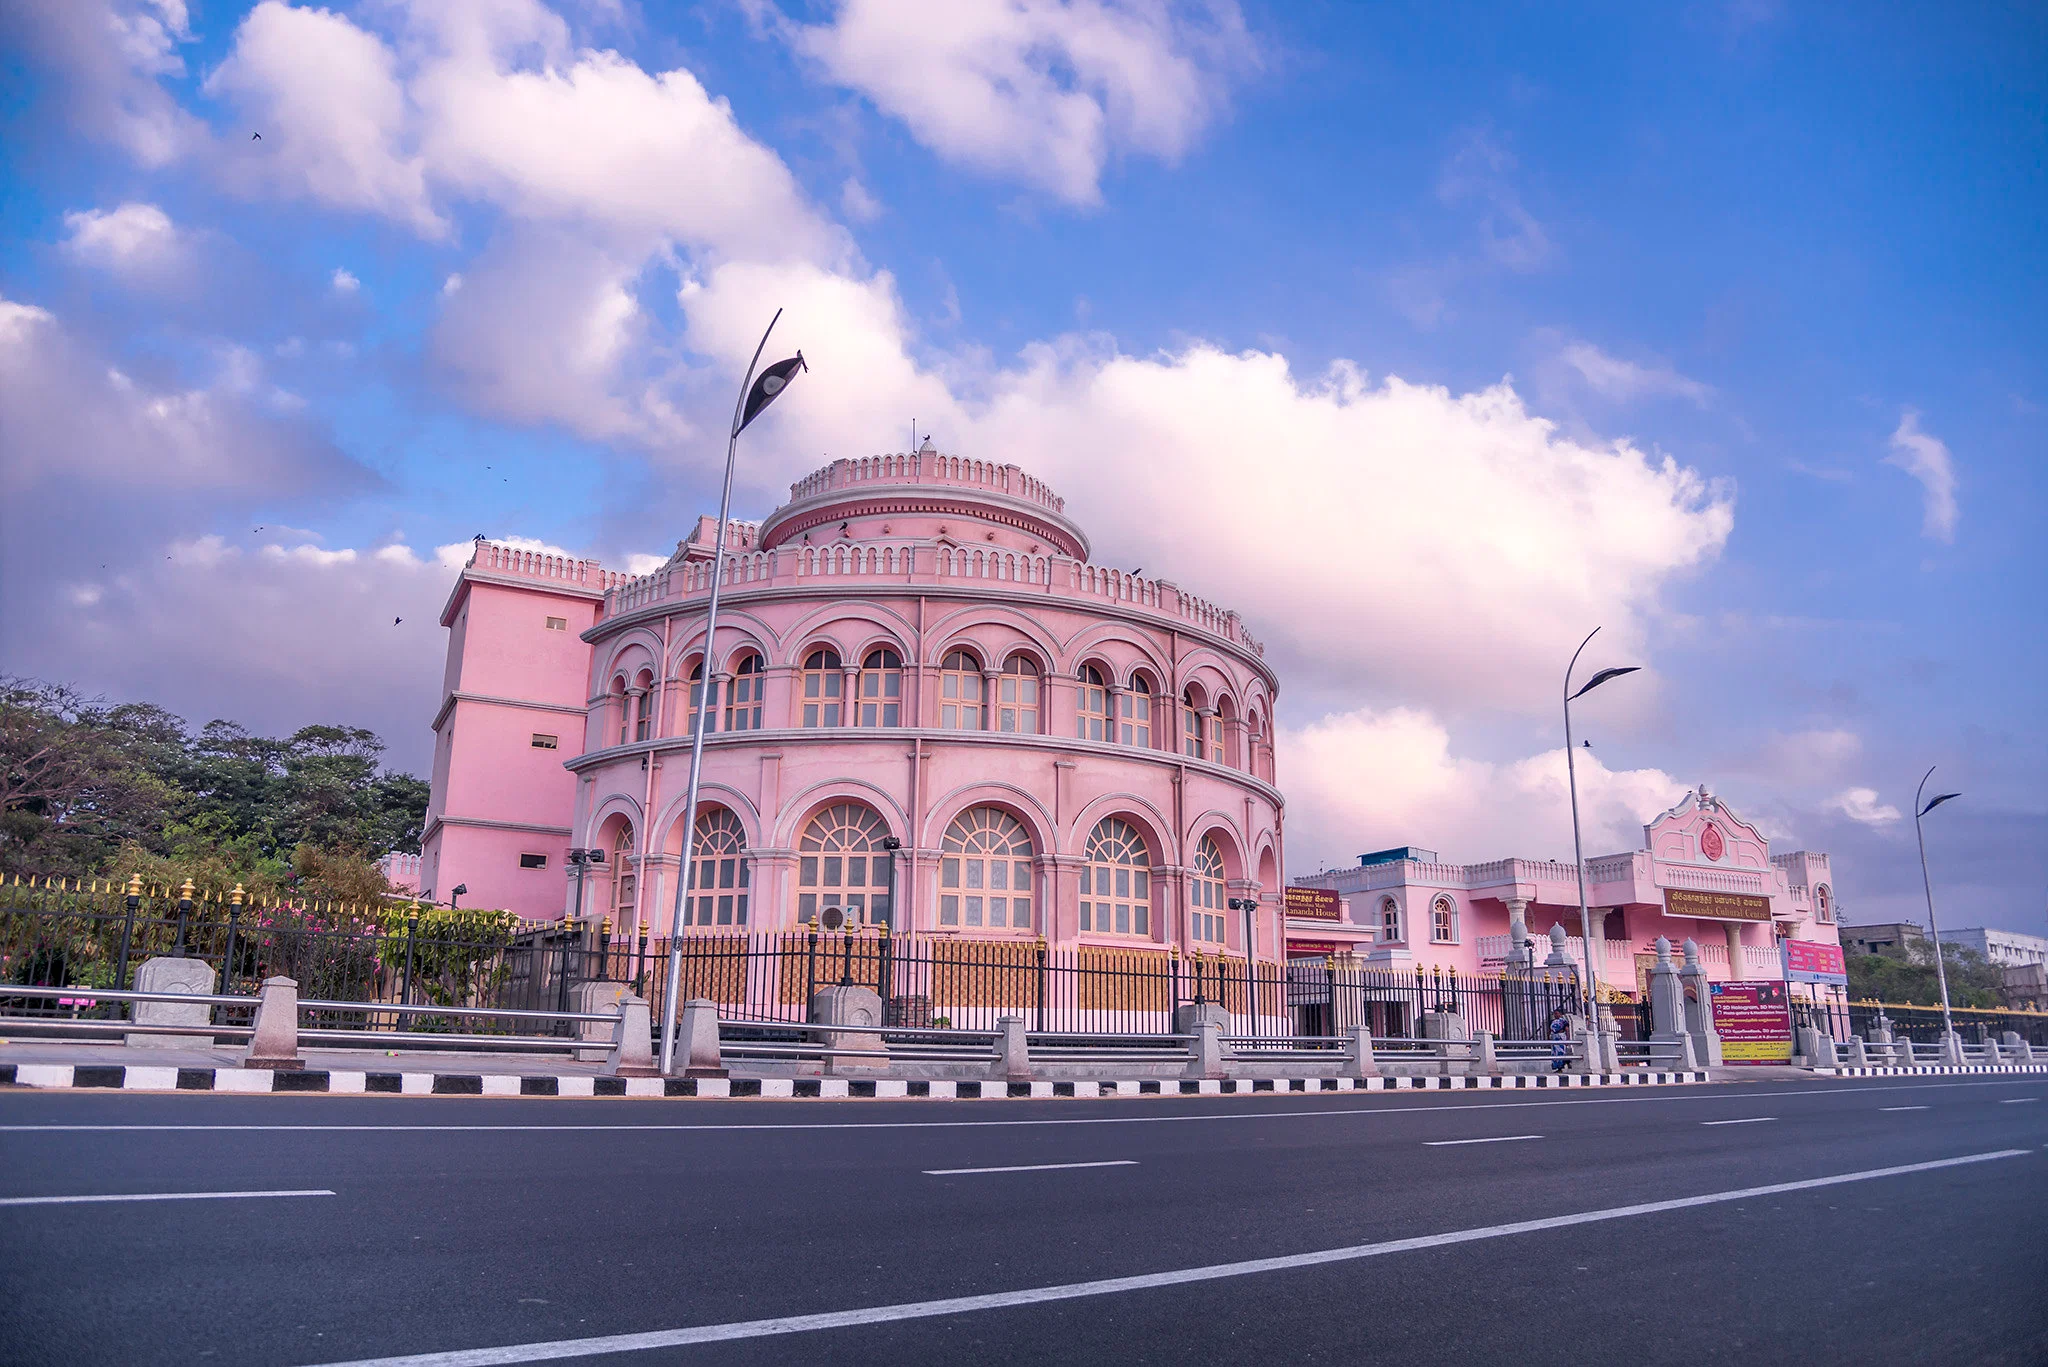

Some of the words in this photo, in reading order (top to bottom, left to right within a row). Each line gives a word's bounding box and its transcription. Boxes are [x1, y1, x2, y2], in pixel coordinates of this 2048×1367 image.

[1316, 908, 1337, 916] House
[1670, 904, 1713, 914] Vivekananda
[1715, 906, 1743, 917] Cultural
[1745, 909, 1767, 919] Centre
